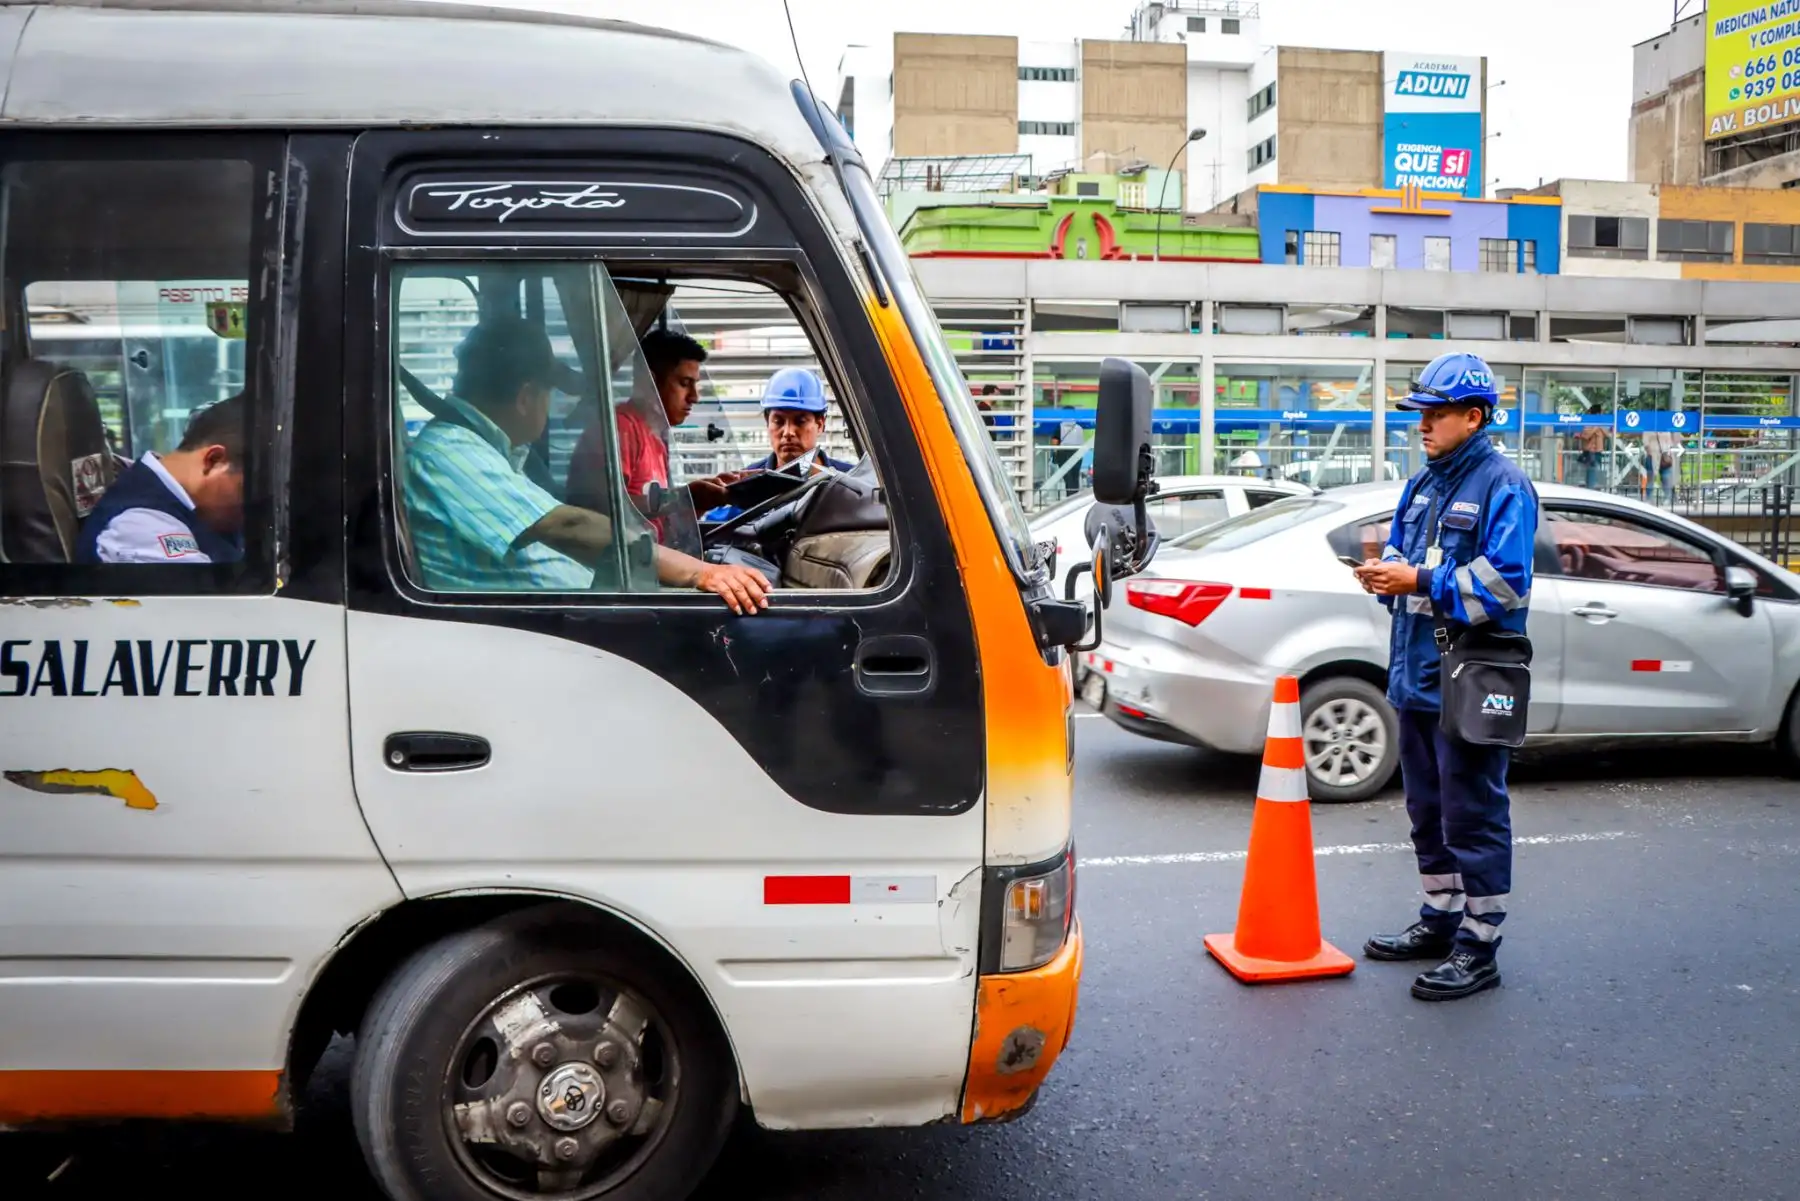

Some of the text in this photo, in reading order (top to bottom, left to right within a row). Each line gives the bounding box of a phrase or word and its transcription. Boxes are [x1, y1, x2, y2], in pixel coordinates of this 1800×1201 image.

[1715, 0, 1800, 36] MEDICINA NATU
[1751, 33, 1758, 48] Y
[1414, 62, 1457, 71] ACADEMIA
[1745, 54, 1776, 78] 666
[1399, 74, 1467, 96] ADUNI
[1744, 69, 1800, 99] 939 08
[1710, 113, 1737, 134] AV.
[1397, 143, 1442, 153] EXIGENCIA
[1394, 151, 1465, 174] QUE SÍ
[1395, 174, 1467, 189] FUNCIONA
[428, 184, 625, 223] Toyota
[1460, 369, 1491, 387] ATU
[0, 640, 316, 696] SALAVERRY
[1482, 693, 1514, 710] ATU
